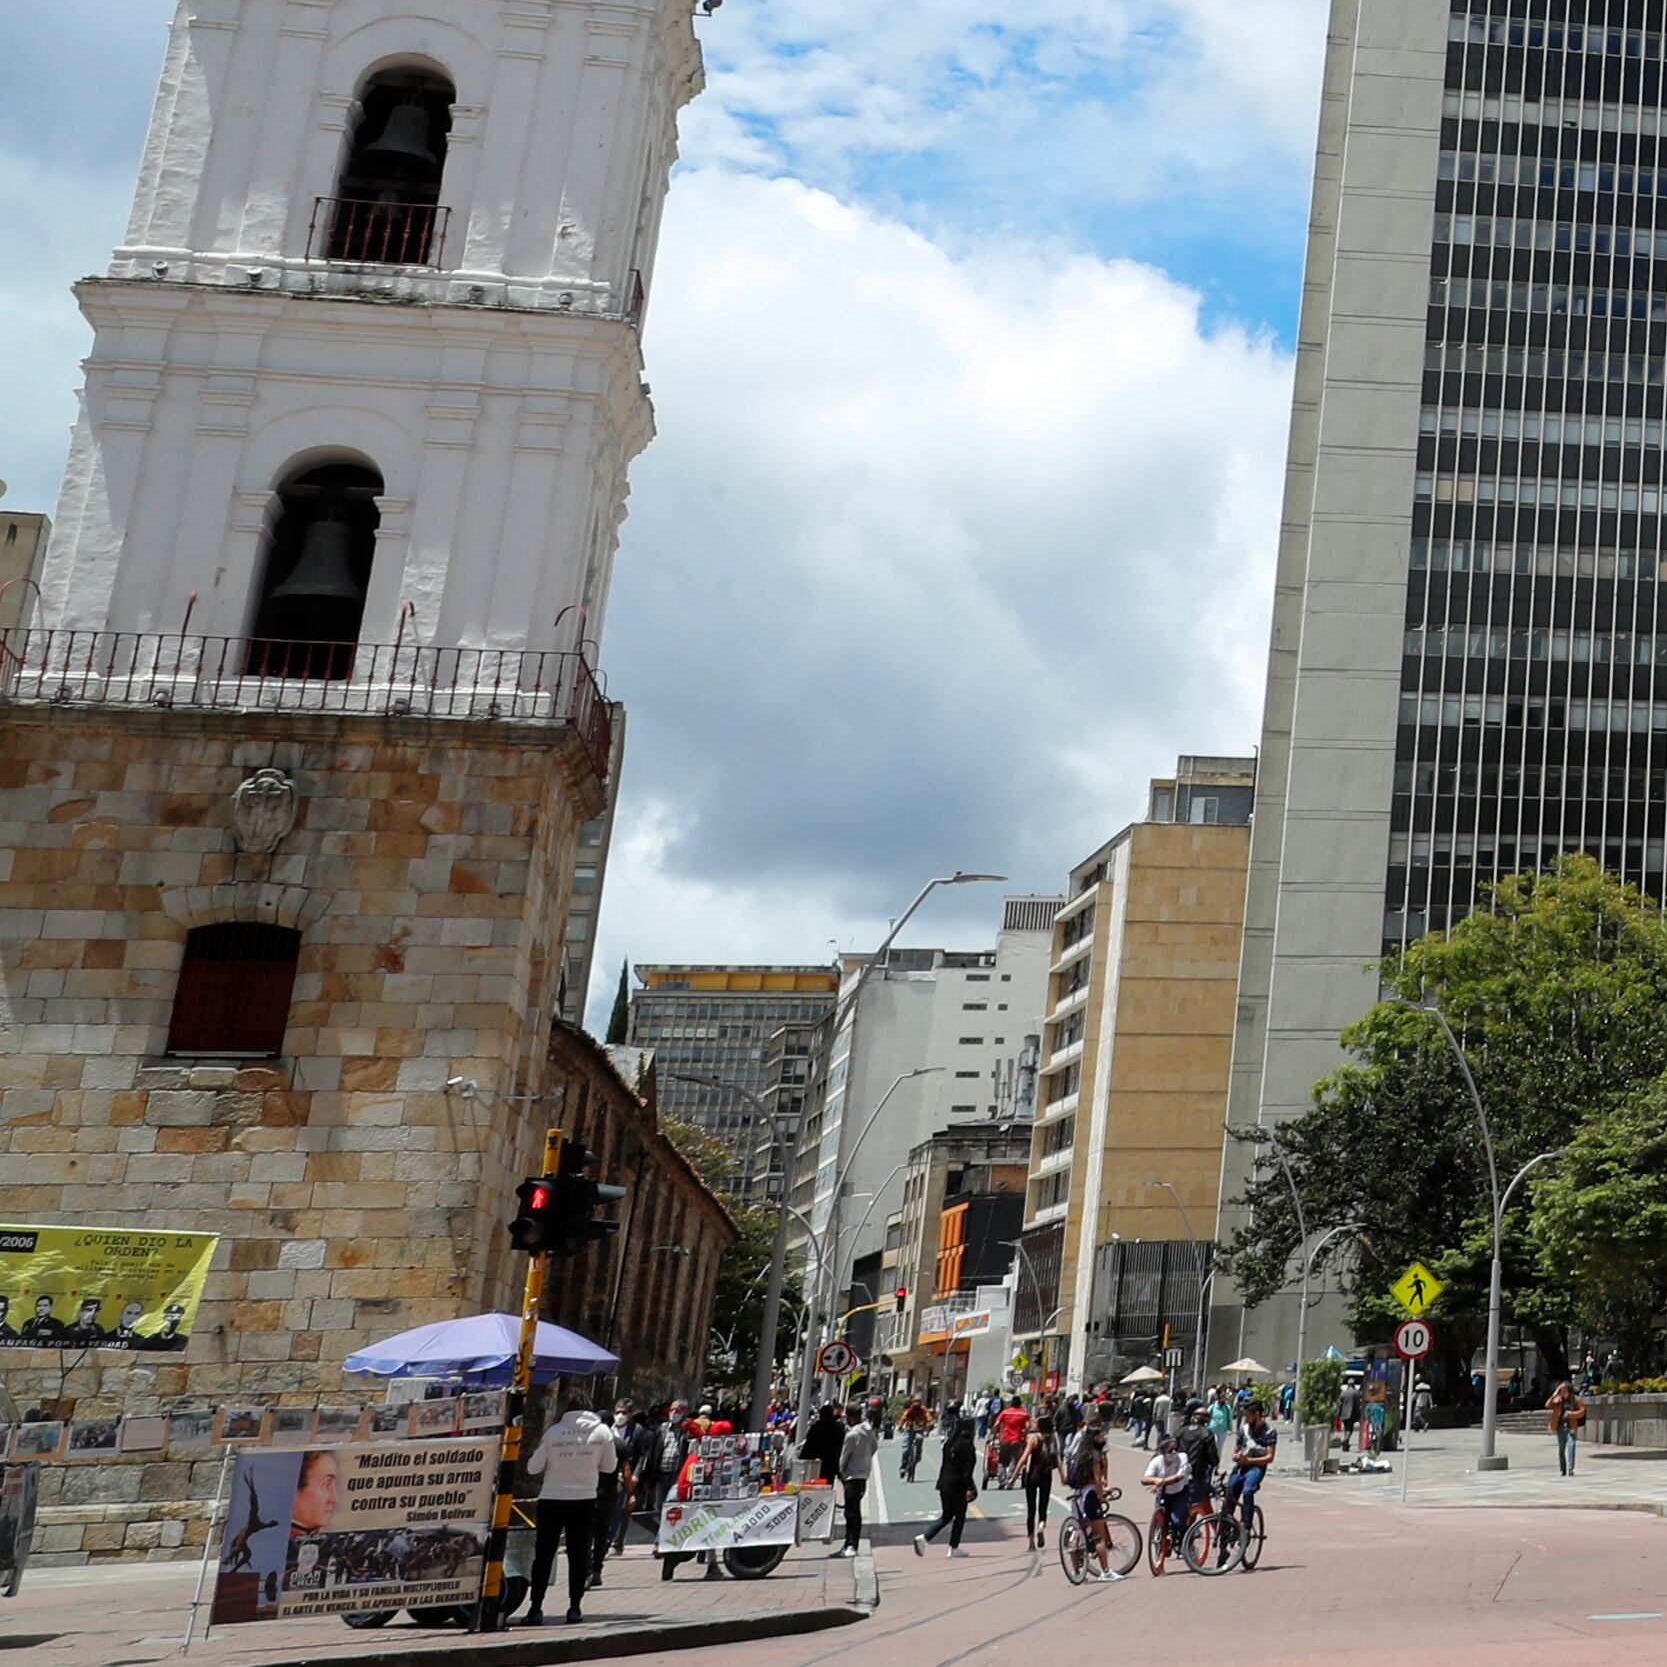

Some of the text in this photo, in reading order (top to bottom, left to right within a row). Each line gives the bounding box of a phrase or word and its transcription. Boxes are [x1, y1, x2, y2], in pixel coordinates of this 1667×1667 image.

[75, 1234, 193, 1248] ¿QUIEN DIO LA
[104, 1246, 159, 1257] ORDEN?
[1404, 1330, 1424, 1348] 10
[414, 1452, 427, 1466] el
[430, 1449, 483, 1464] soldado
[348, 1471, 482, 1491] que apunta su arma
[351, 1495, 396, 1511] contra
[400, 1495, 415, 1508] su
[302, 1591, 320, 1602] POR
[321, 1590, 331, 1601] LA
[332, 1589, 350, 1600] VIDA
[351, 1589, 357, 1598] Y
[358, 1588, 369, 1598] SU
[370, 1585, 401, 1597] FAMILIA
[283, 1606, 291, 1616] EL
[293, 1604, 313, 1615] ARTE
[314, 1603, 325, 1614] DE
[361, 1600, 371, 1610] SE
[371, 1597, 408, 1610] APRENDE
[409, 1596, 419, 1606] EN
[420, 1595, 435, 1605] LAS
[435, 1591, 474, 1604] DERROTAS
